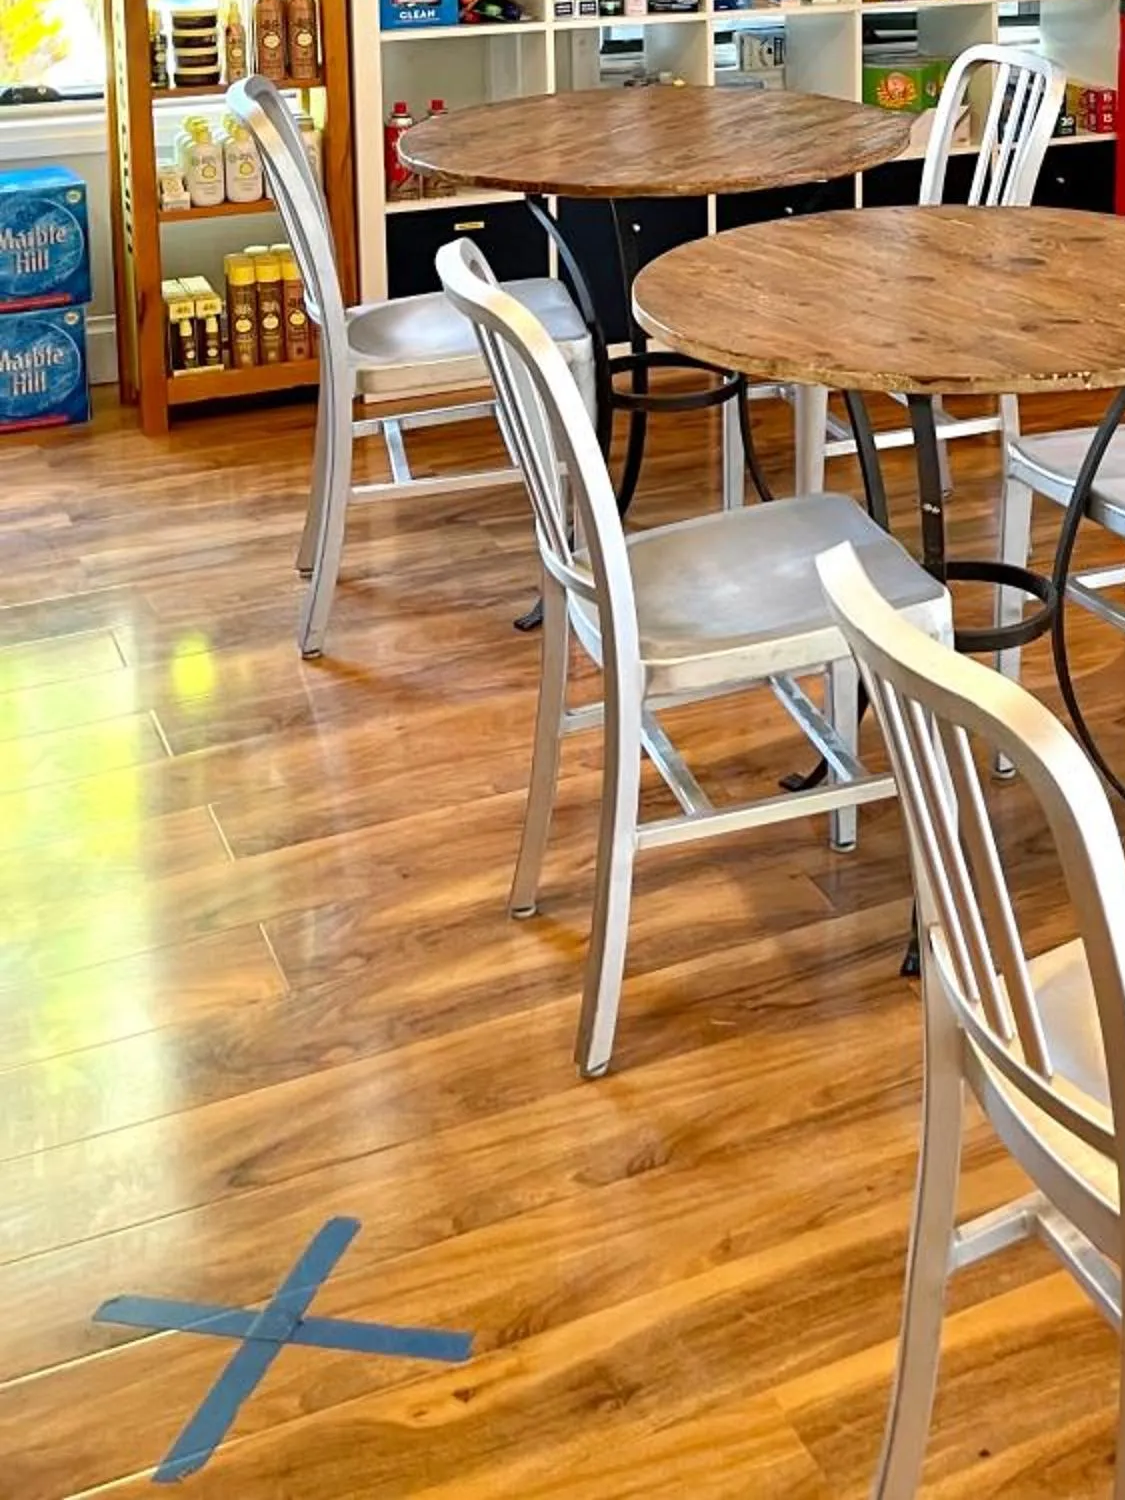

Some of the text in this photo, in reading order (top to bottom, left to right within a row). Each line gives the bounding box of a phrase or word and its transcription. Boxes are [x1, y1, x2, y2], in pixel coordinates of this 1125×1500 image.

[399, 9, 436, 20] CLEAN
[0, 225, 67, 251] Marble
[14, 252, 49, 275] Hill
[0, 345, 64, 373] Marble
[12, 371, 47, 397] Hill
